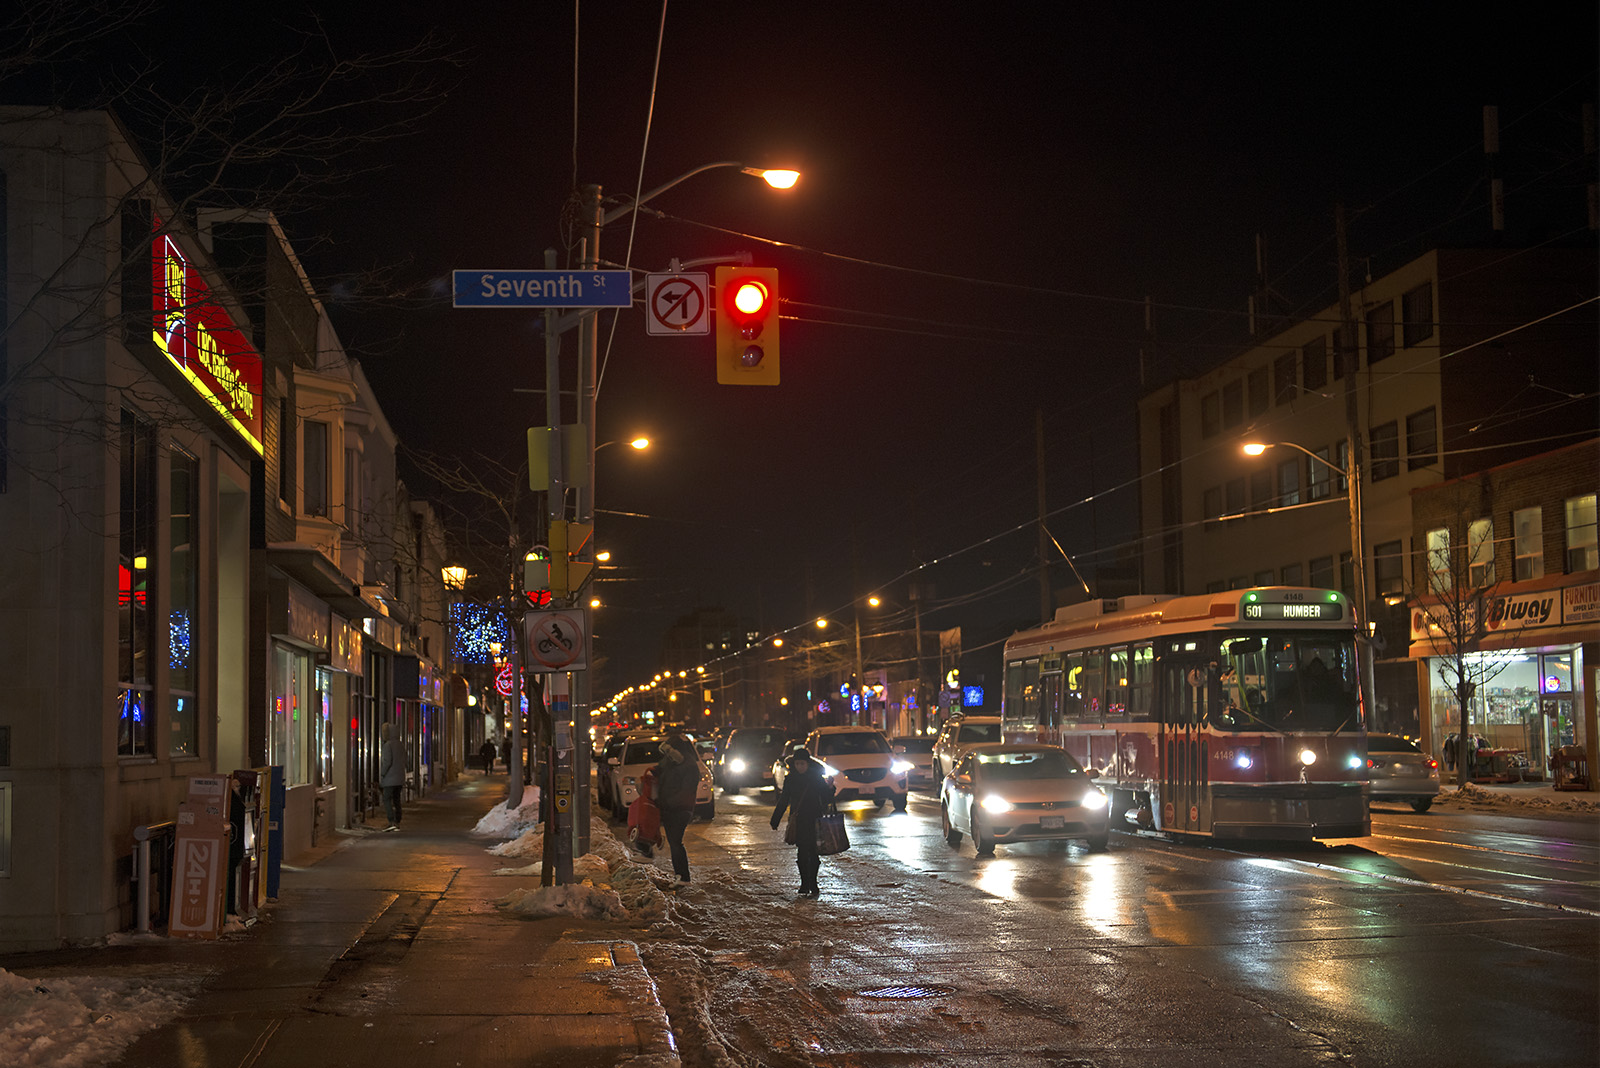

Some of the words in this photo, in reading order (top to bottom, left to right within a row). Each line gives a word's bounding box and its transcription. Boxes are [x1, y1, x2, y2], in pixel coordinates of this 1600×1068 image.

[481, 274, 583, 298] Seventh
[593, 275, 606, 287] St
[1283, 593, 1304, 601] 4148
[1565, 584, 1600, 606] FURNITU
[1246, 605, 1262, 618] 501
[1283, 605, 1321, 618] HUMBER
[1490, 597, 1554, 624] Biway
[1213, 750, 1235, 761] 4148
